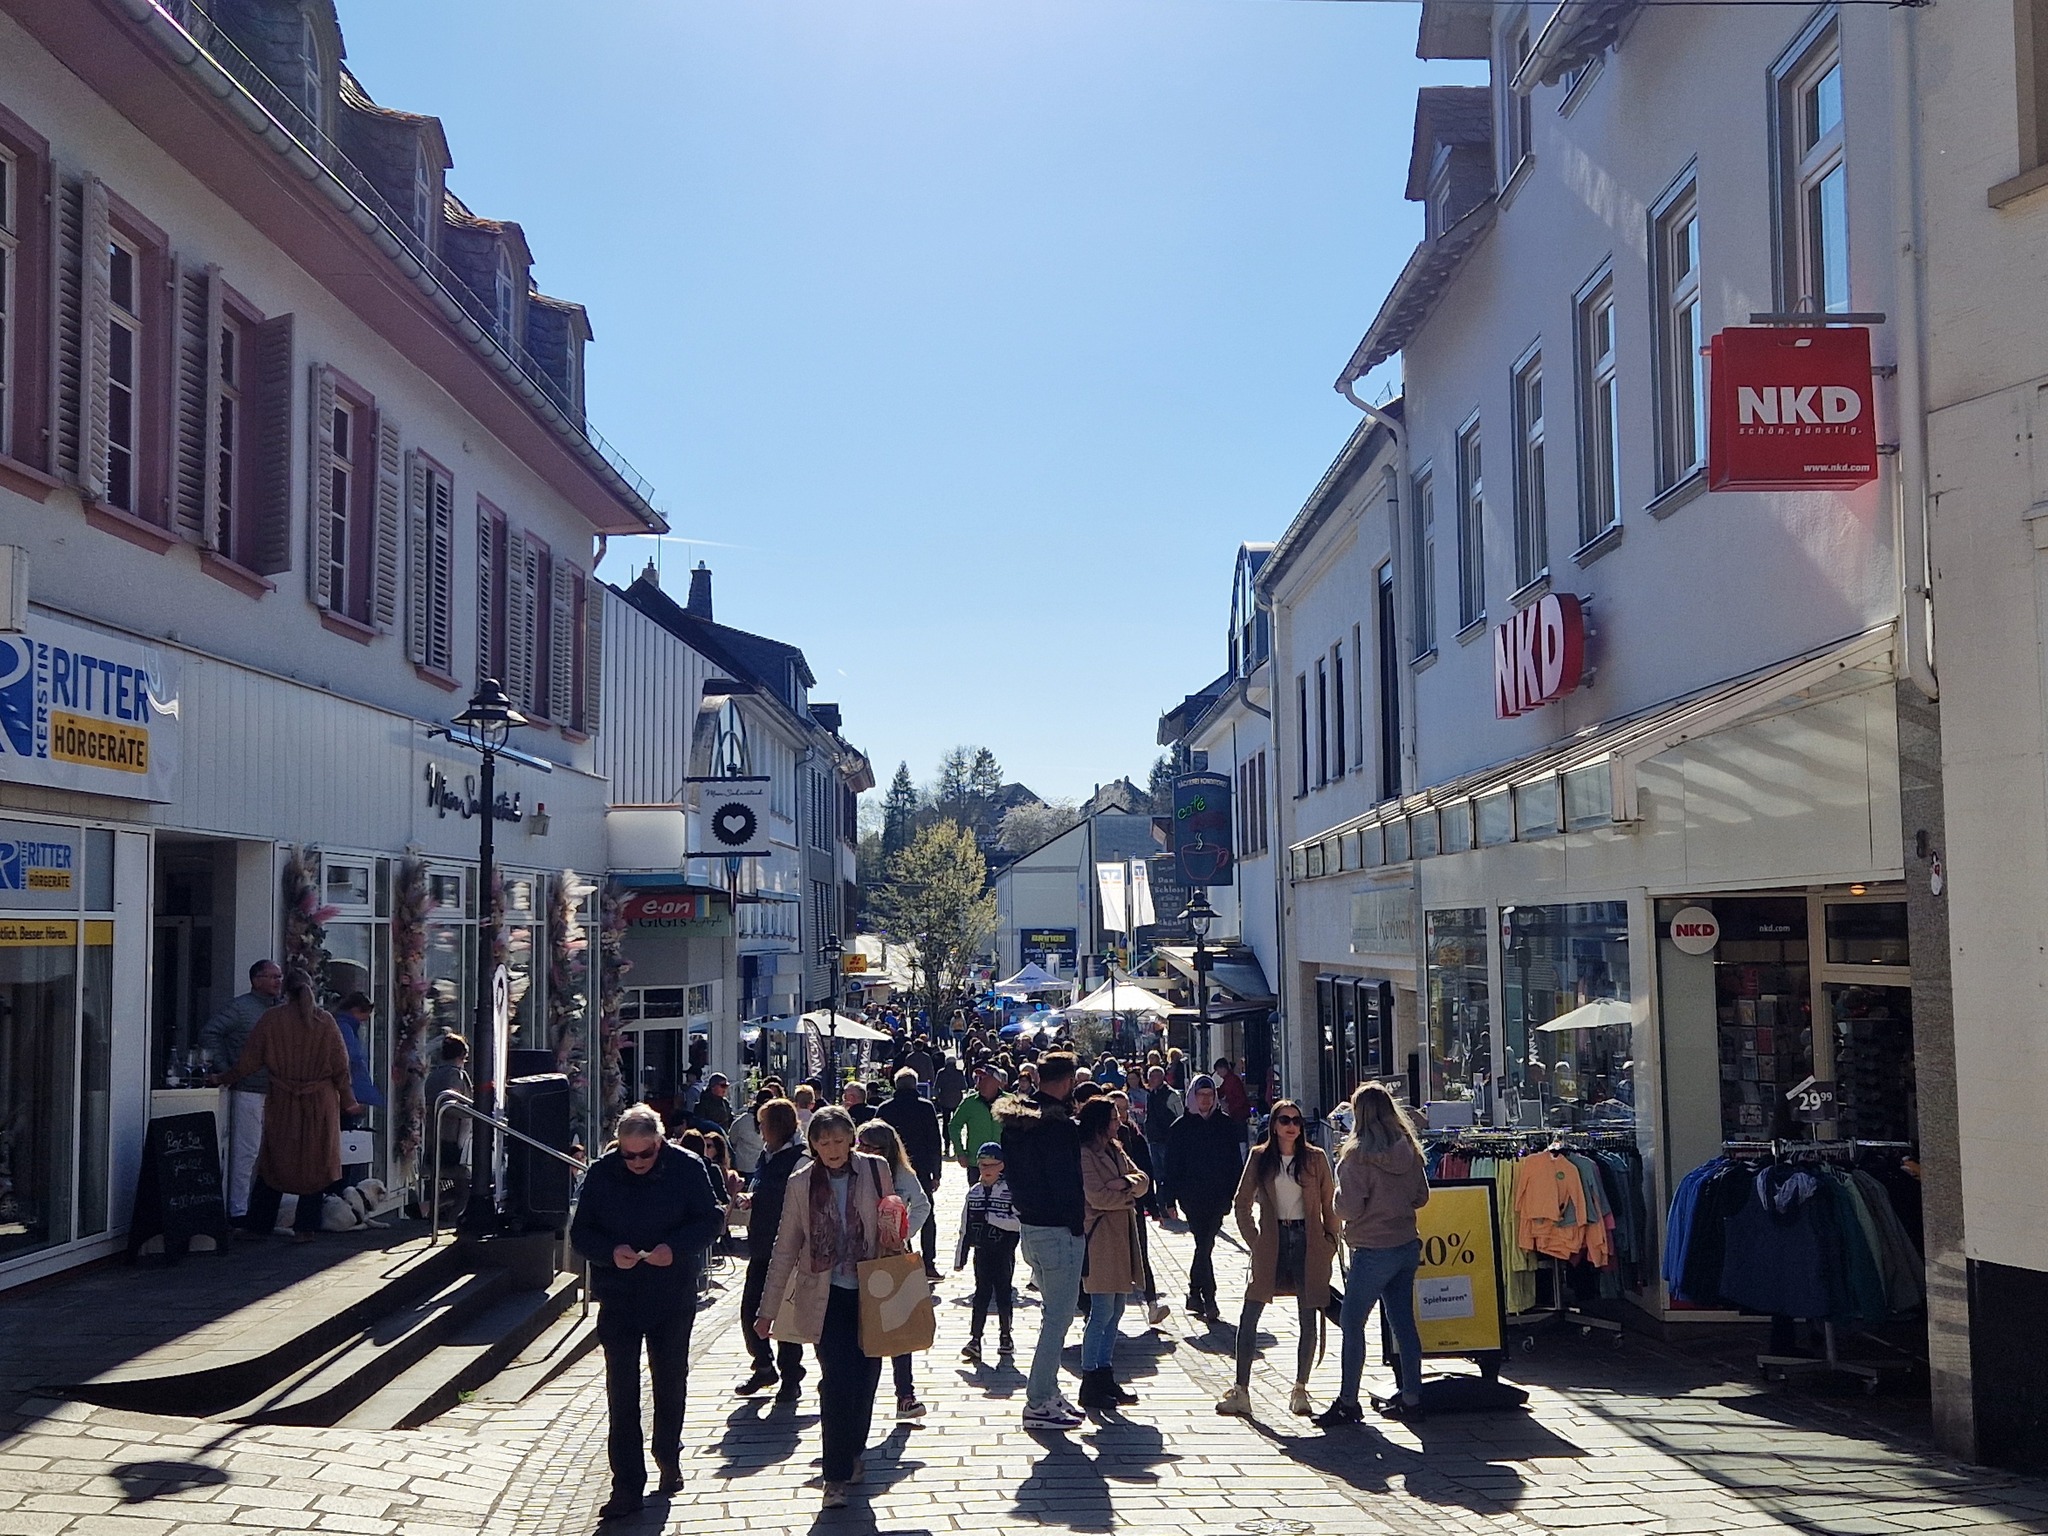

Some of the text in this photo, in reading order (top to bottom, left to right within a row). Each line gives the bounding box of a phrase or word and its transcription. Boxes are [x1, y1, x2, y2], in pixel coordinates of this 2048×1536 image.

[1738, 386, 1862, 424] NKD
[1803, 464, 1870, 472] www.nkd.com
[1494, 593, 1565, 719] NKD
[52, 647, 149, 723] RITTER
[36, 643, 48, 759] KERSTIN
[54, 719, 145, 767] HÖRGERÄTE
[28, 842, 71, 868] RITTER
[28, 871, 70, 888] HÖRGERÄTE
[20, 926, 45, 939] Besser.
[46, 926, 68, 939] Hören.
[1676, 924, 1715, 937] NKD
[1759, 924, 1790, 933] nkd.com
